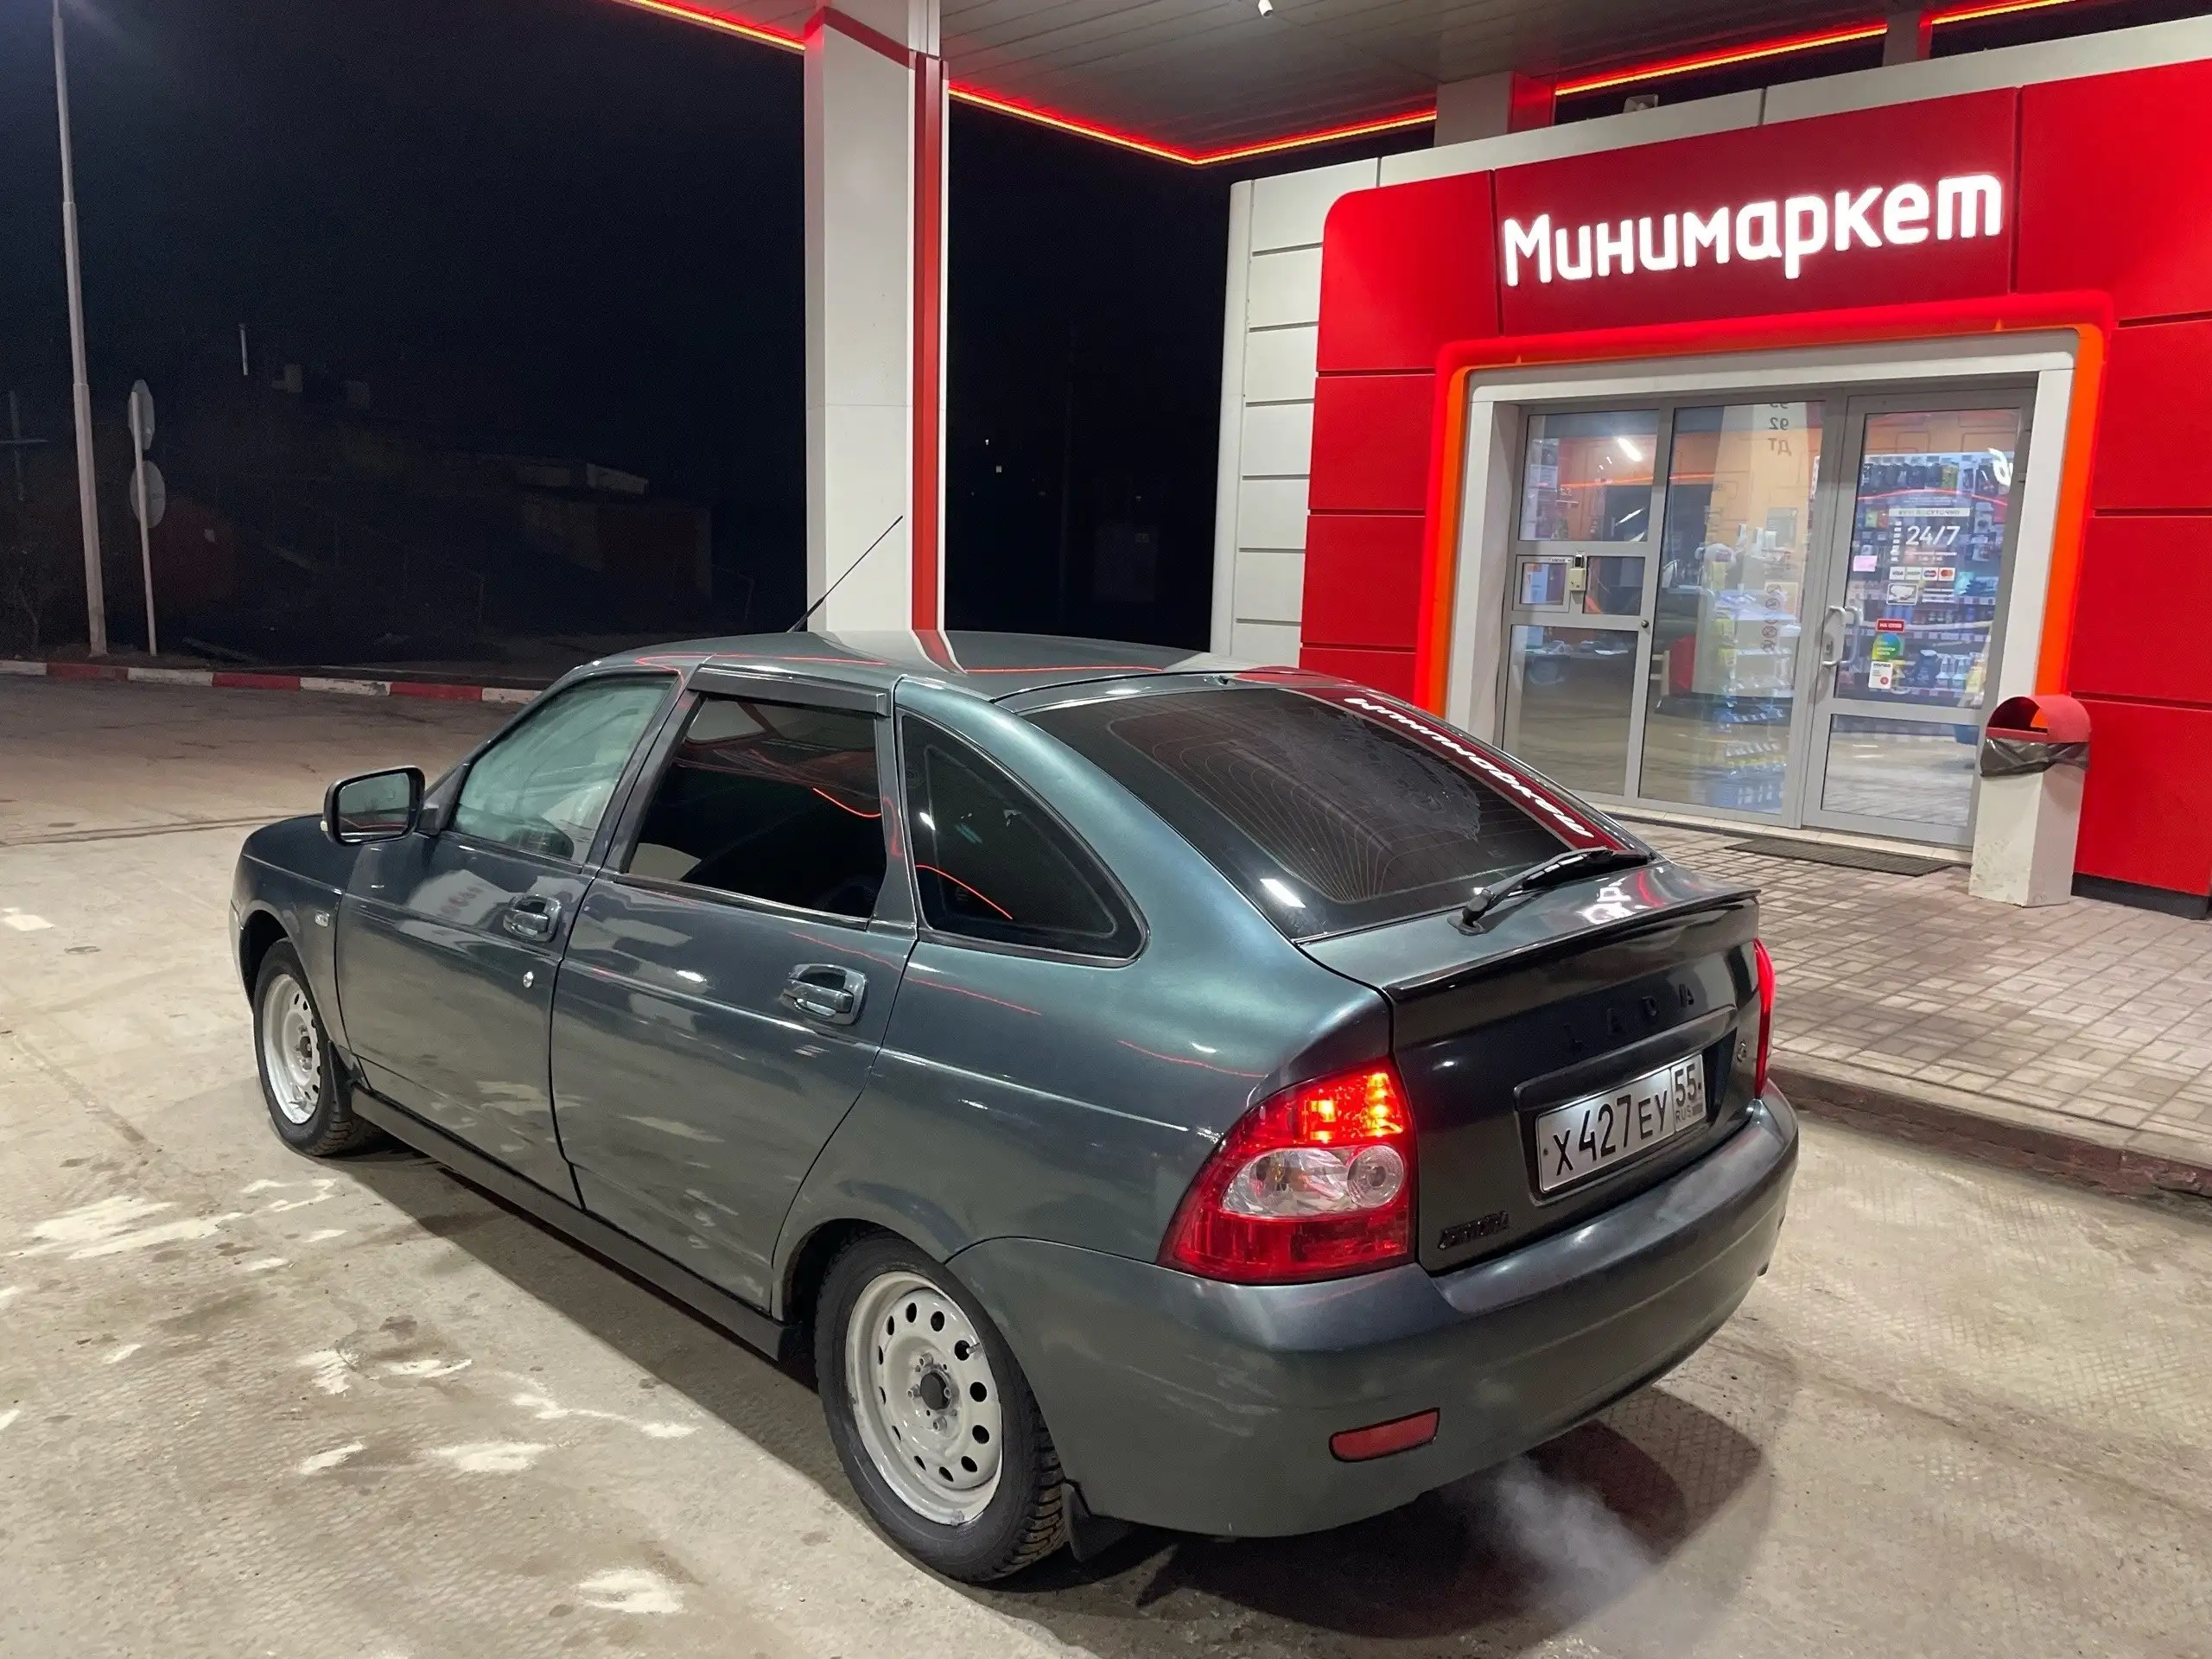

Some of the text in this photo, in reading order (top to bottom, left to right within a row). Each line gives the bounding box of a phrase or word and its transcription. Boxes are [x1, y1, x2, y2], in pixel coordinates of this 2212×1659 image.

[1503, 173, 2003, 287] Минимаркет
[1905, 525, 1961, 546] 24/7
[1674, 1063, 1697, 1107] 55
[1675, 1104, 1693, 1124] RUS
